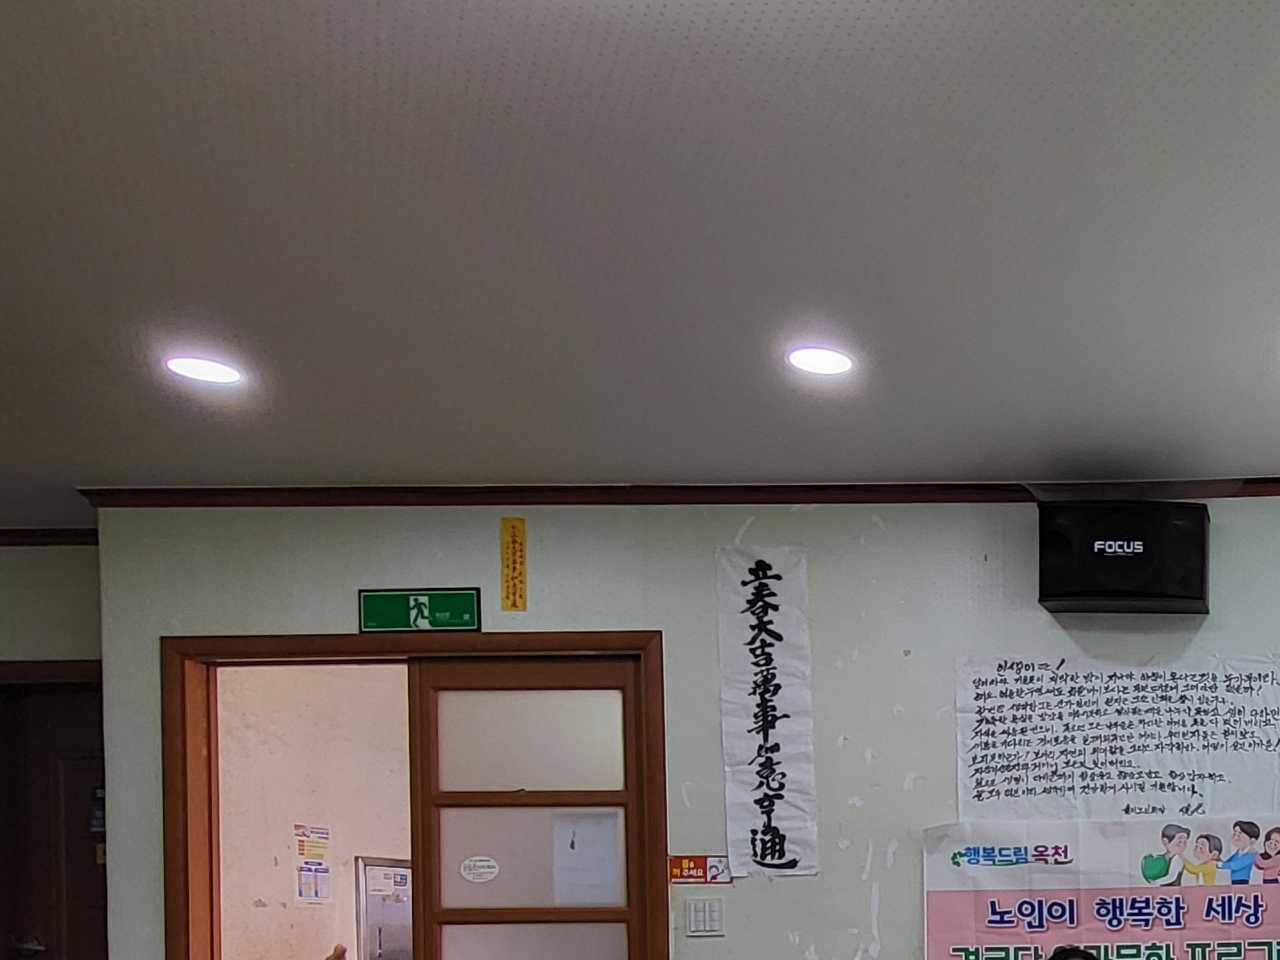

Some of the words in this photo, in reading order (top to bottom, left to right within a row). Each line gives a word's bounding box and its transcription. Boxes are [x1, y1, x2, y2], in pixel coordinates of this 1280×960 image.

[1094, 541, 1144, 553] FOCUS
[964, 846, 1028, 865] 행복드림
[1031, 845, 1069, 865] 옥천
[986, 898, 1078, 932] 노인이
[1095, 895, 1187, 930] 행복한
[1203, 893, 1265, 928] 세상
